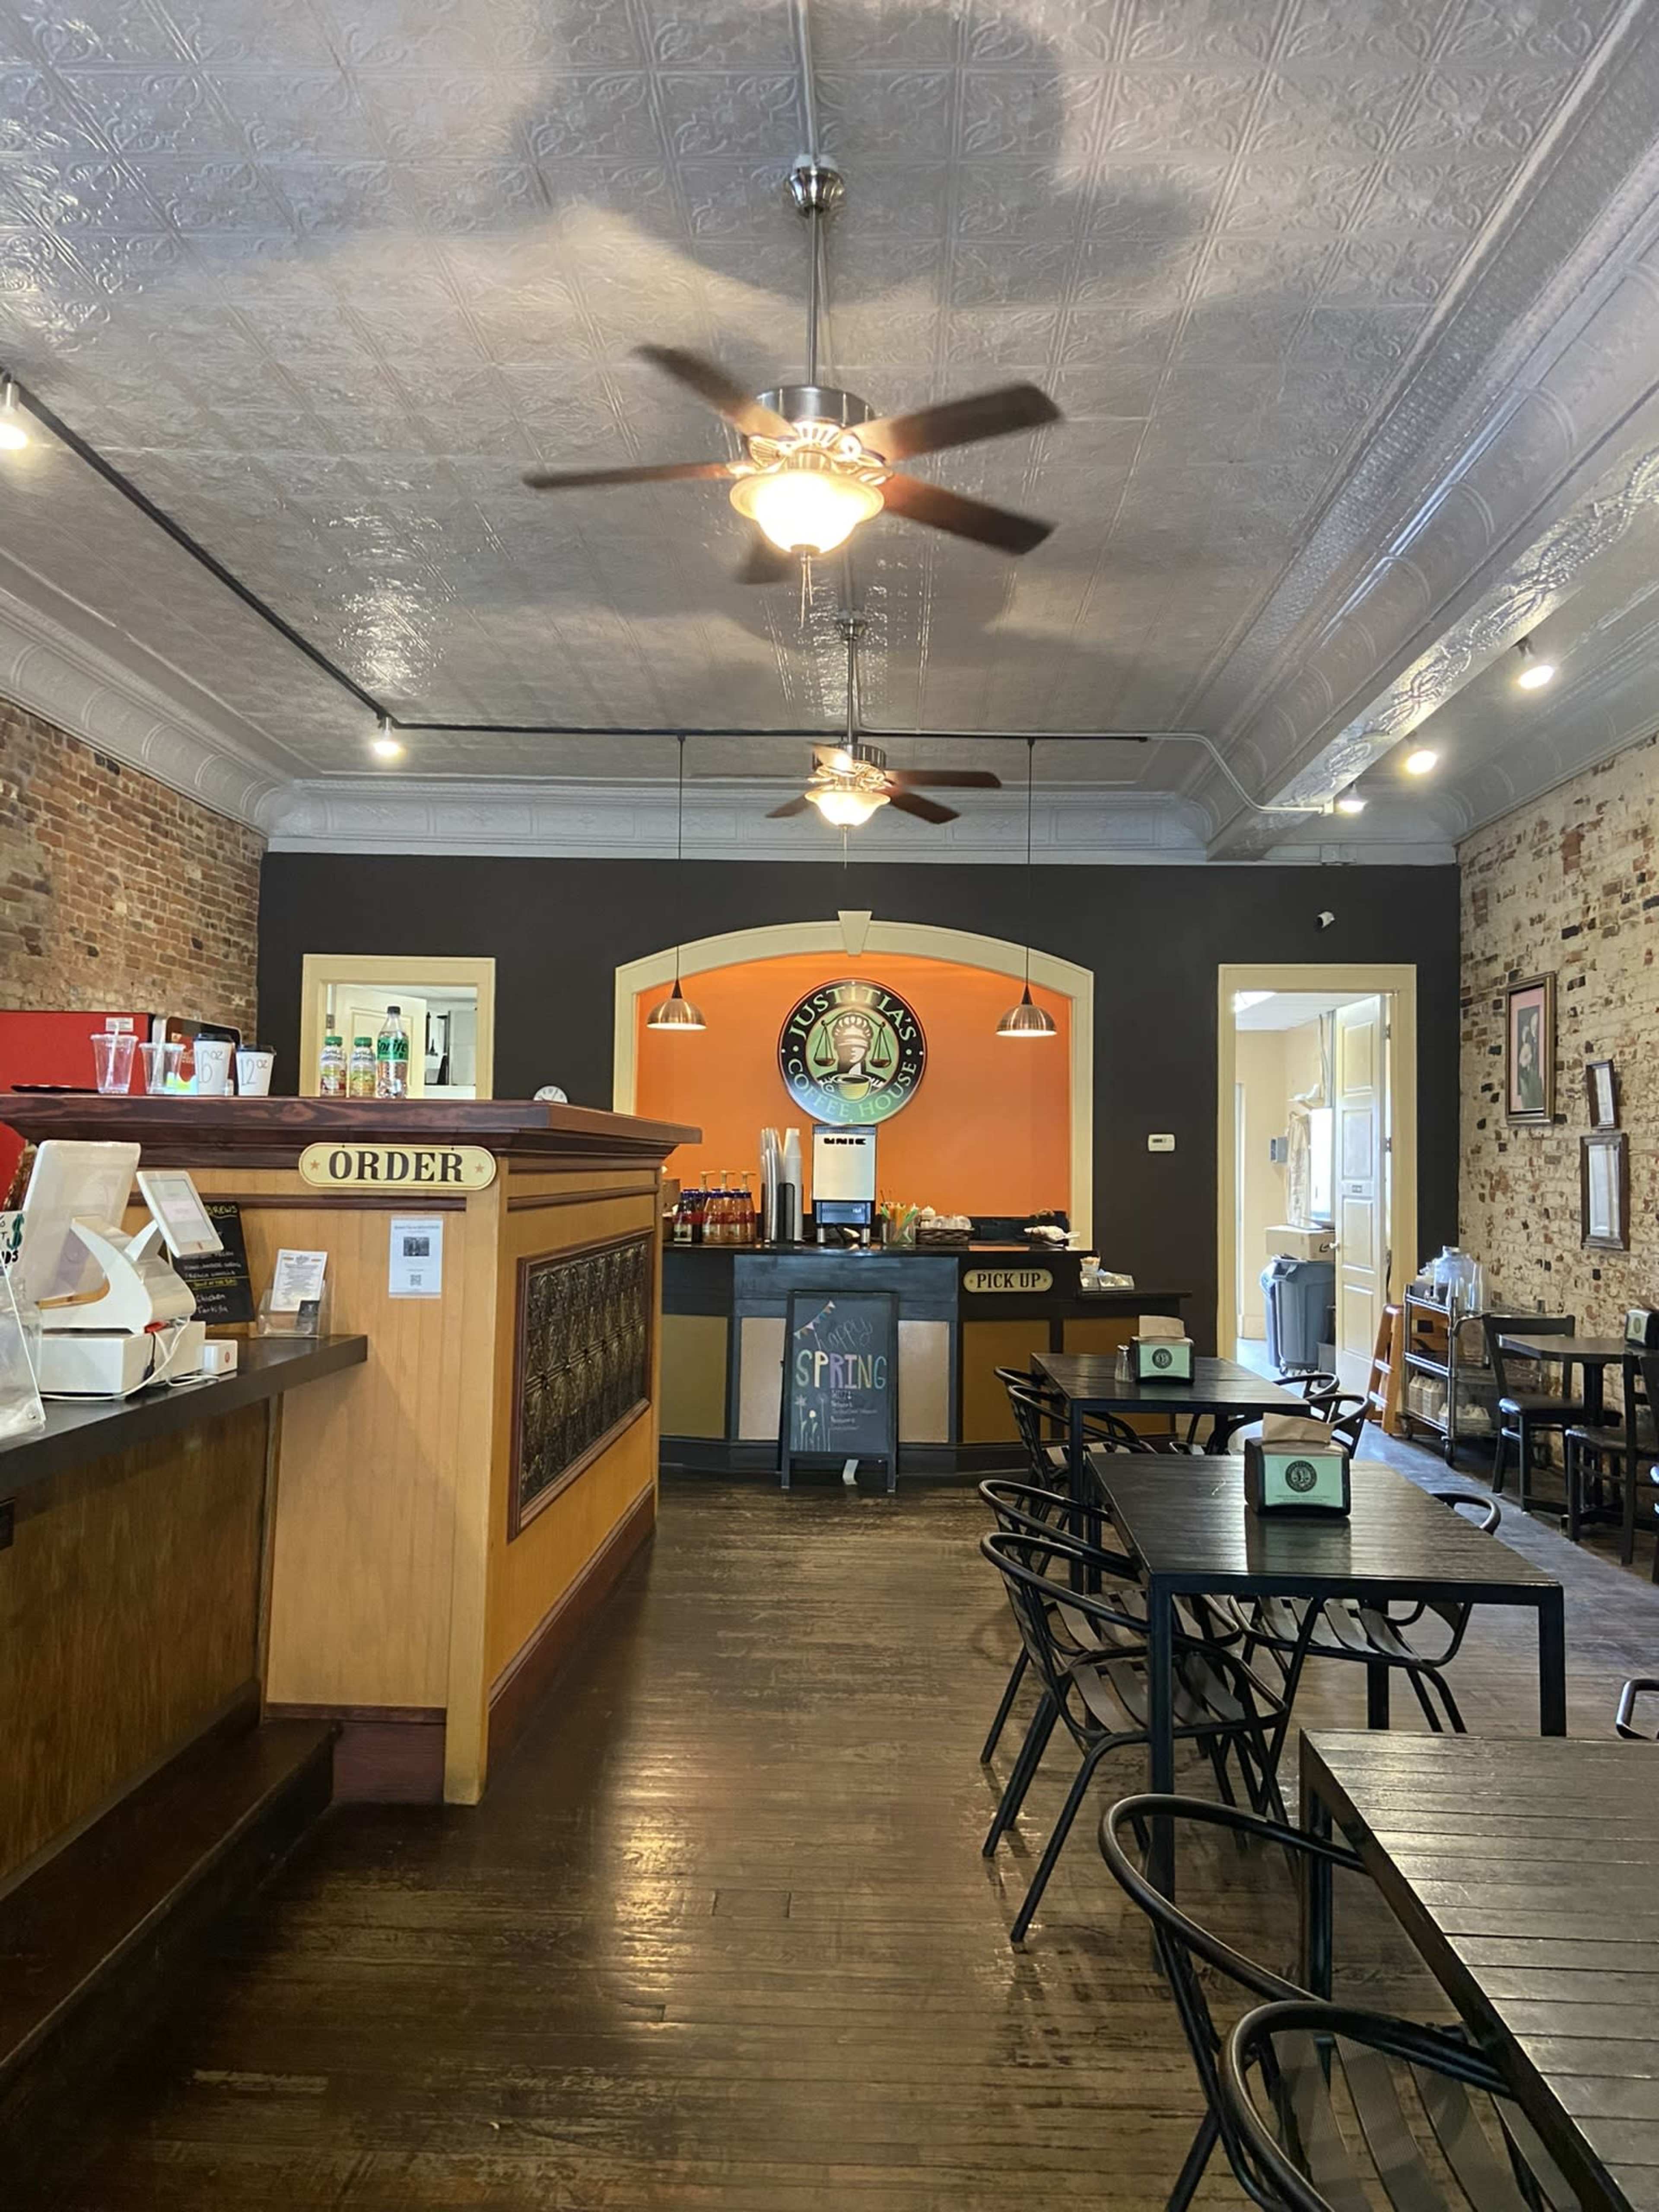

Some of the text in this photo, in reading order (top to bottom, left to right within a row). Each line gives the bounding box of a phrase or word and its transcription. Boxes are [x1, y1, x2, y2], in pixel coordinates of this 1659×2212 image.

[788, 985, 917, 1042] JUSTITIA'S
[241, 1058, 257, 1086] 12
[788, 1058, 917, 1118] COFFEE HOUSE
[328, 1150, 464, 1183] ORDER
[977, 1272, 1041, 1288] PICK UP
[795, 1349, 887, 1390] SPRING
